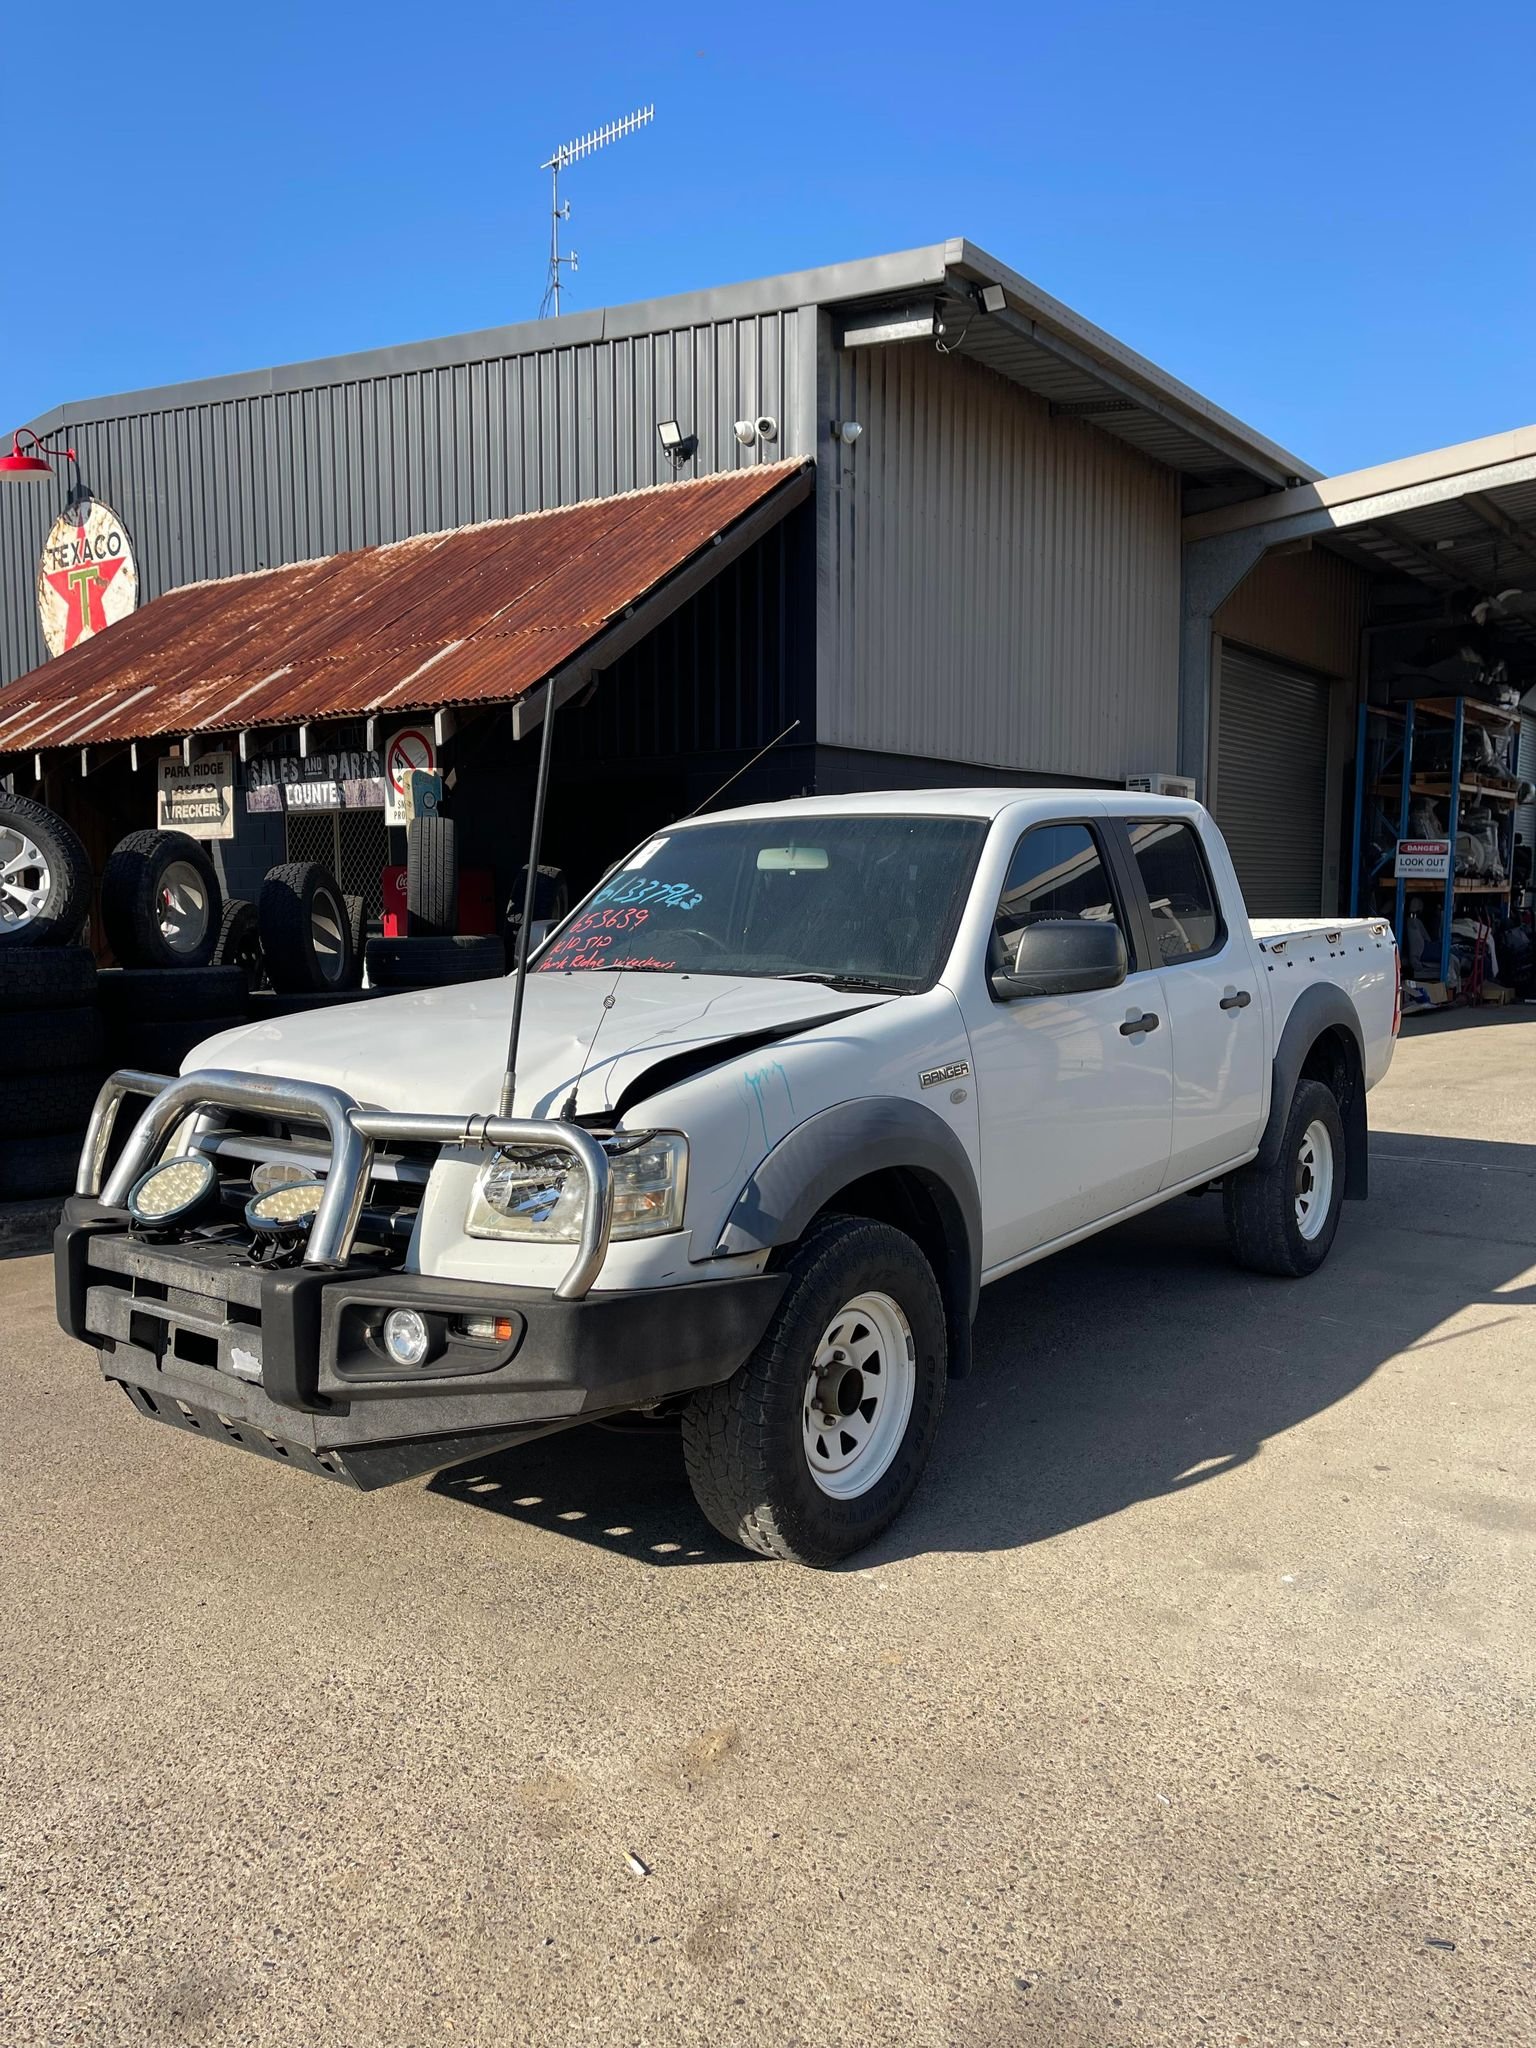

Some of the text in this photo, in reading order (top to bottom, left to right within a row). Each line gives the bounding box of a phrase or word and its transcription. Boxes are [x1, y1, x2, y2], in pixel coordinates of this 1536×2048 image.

[47, 531, 122, 571] TEXACO
[164, 762, 224, 779] PARK RIDGE
[250, 751, 381, 793] SALES AND PARTS
[1400, 858, 1445, 866] LOOK OUT
[922, 1063, 969, 1086] RANGER
